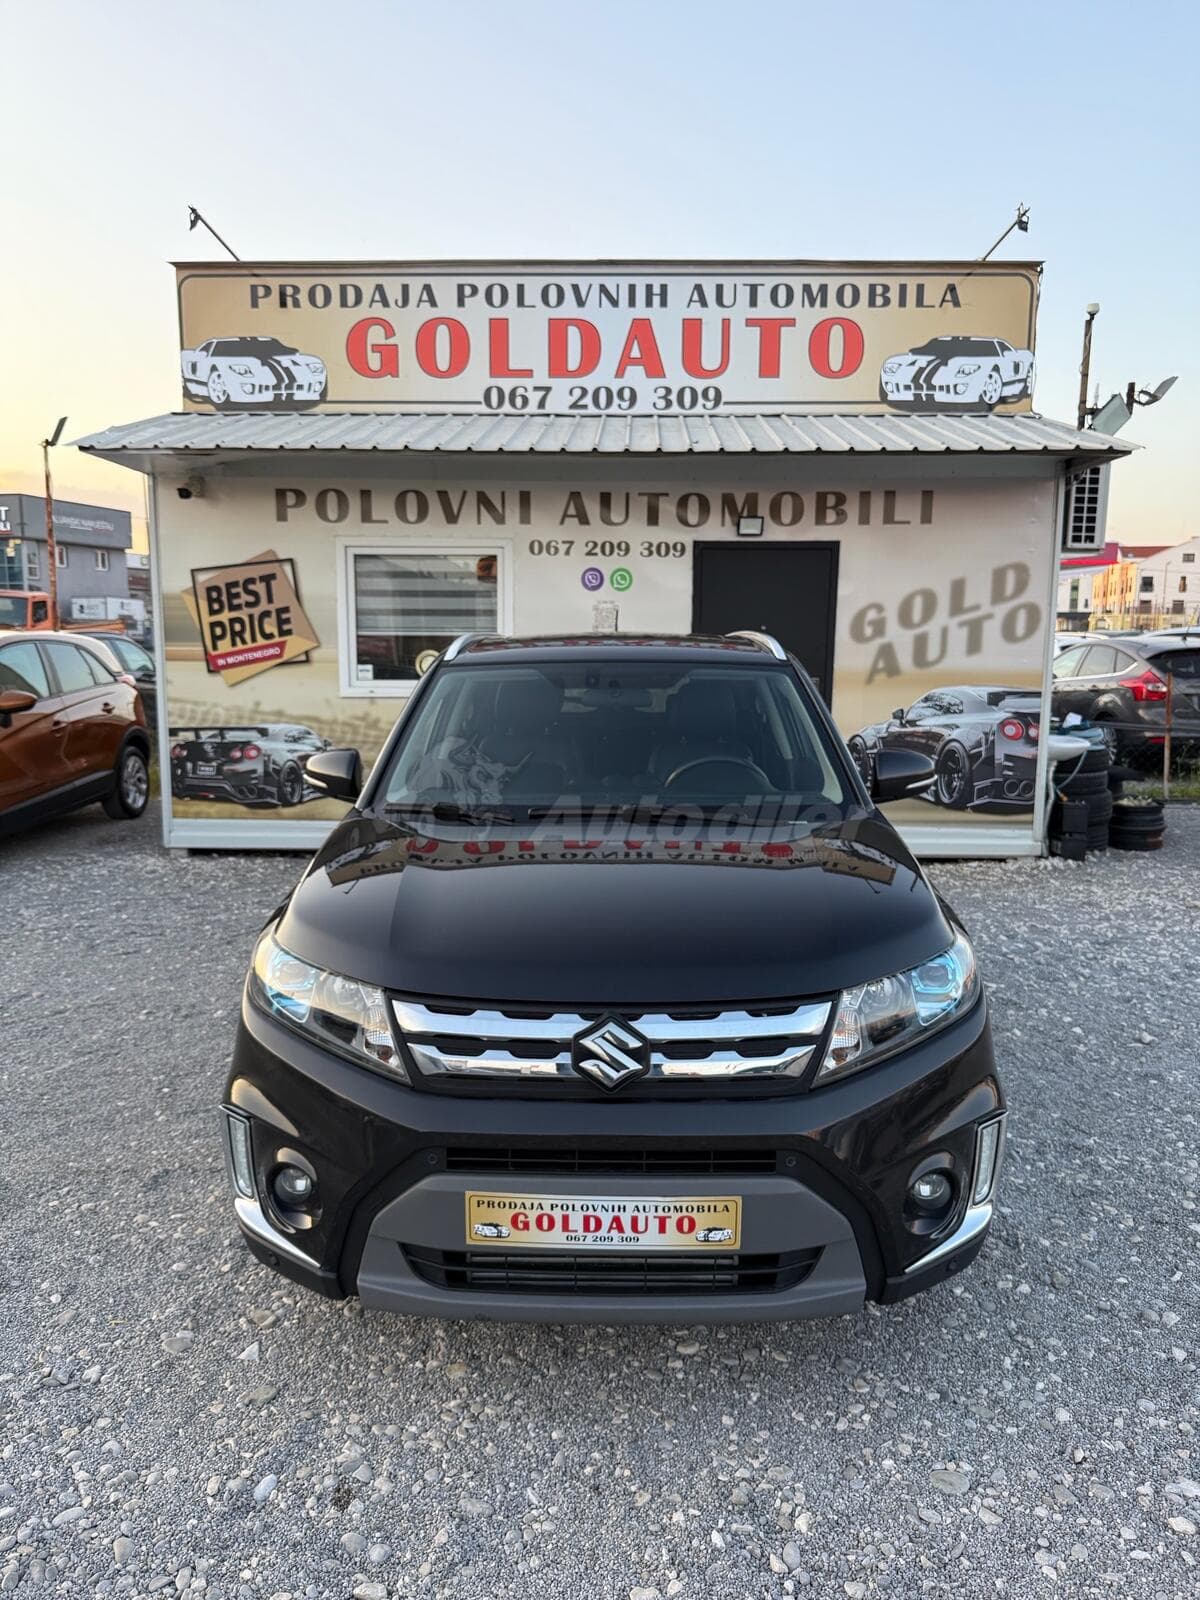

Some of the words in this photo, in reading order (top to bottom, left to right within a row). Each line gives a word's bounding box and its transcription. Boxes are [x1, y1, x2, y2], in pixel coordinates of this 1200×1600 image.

[250, 282, 439, 310] PRODAJA
[455, 282, 669, 309] POLOVNIH
[686, 282, 963, 309] AUTOMOBILA
[345, 316, 866, 380] GOLDAUTO
[483, 385, 553, 411] 067
[568, 385, 638, 411] 209
[653, 385, 723, 411] 309
[274, 487, 532, 525] POLOVNI
[559, 489, 935, 528] AUTOMOBILI
[528, 539, 575, 557] 067
[584, 540, 631, 558] 209
[639, 540, 687, 559] 309
[205, 573, 277, 616] BEST
[849, 561, 1030, 645] GOLD
[209, 606, 293, 652] PRICE
[865, 601, 1042, 685] AUTO
[216, 658, 227, 666] IN
[227, 647, 281, 664] MONTENEGRO
[477, 1200, 544, 1211] PRODAJA
[550, 1203, 627, 1213] POLOVNIH
[632, 1204, 730, 1214] AUTOMOBILA
[510, 1212, 697, 1234] GOLDAUTO
